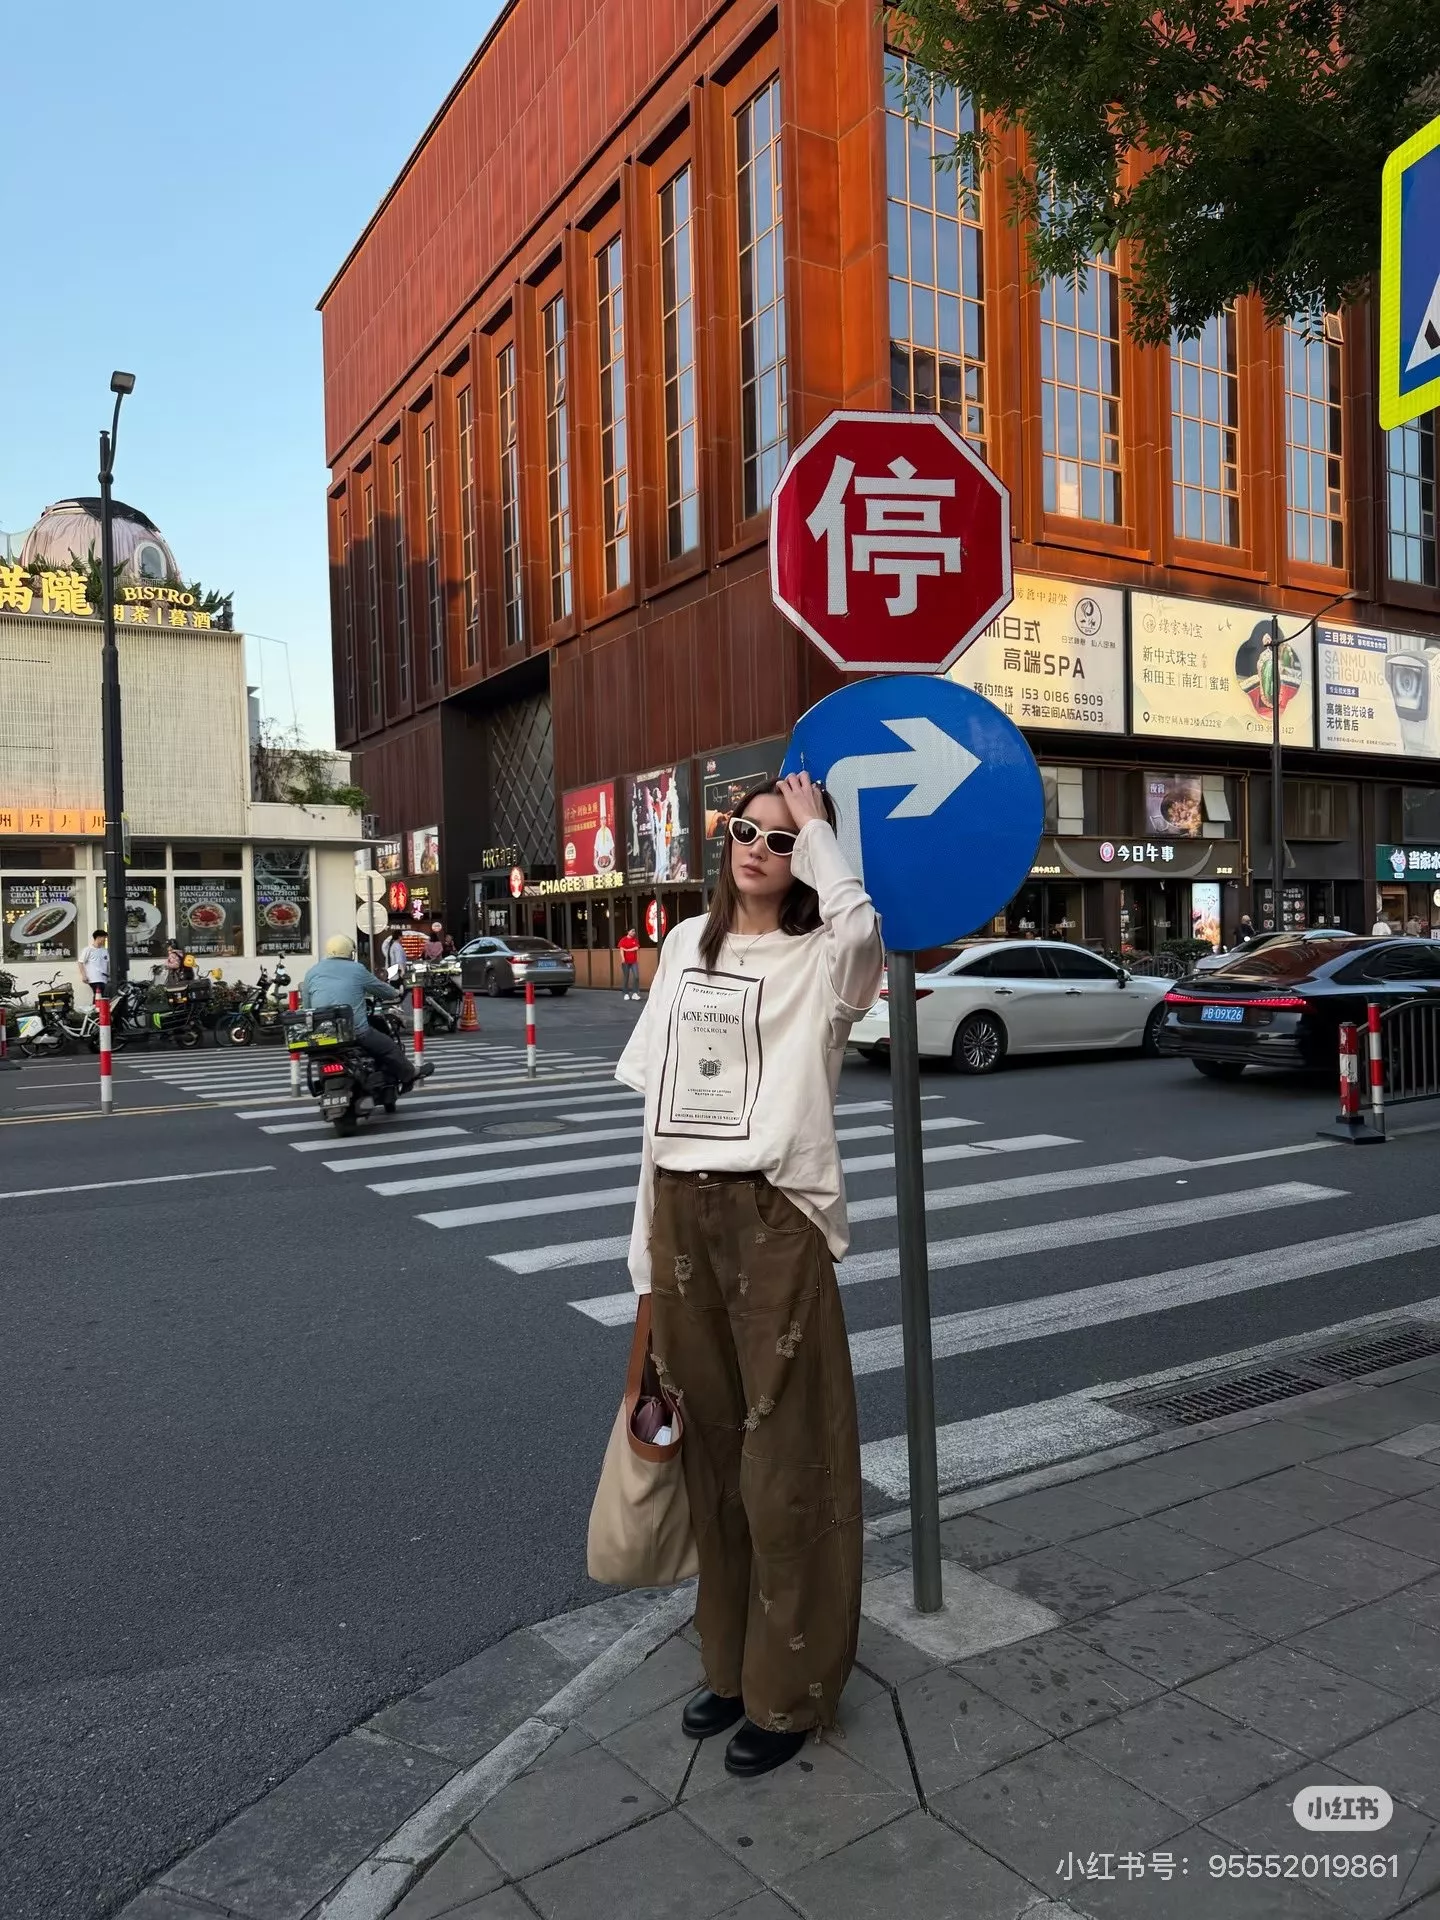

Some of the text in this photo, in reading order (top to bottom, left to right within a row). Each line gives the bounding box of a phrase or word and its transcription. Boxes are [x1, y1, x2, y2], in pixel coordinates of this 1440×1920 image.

[805, 455, 961, 616] 停
[122, 586, 195, 606] BISTRO
[1324, 631, 1355, 646] 三目视光
[1003, 648, 1085, 680] 高端SPA
[1143, 646, 1197, 667] 新中式珠宝
[1325, 650, 1366, 669] SANMU
[1325, 665, 1385, 686] SHIGUANG
[1022, 688, 1039, 700] 153
[1044, 690, 1069, 703] 0186
[1074, 693, 1104, 707] 6909
[1326, 703, 1375, 719] 高端验光设备
[1326, 717, 1359, 731] 无忧售后
[1117, 843, 1174, 862] 今日牛事
[540, 878, 581, 896] CHAGEE
[681, 1011, 740, 1025] ACNE STUDIOS
[693, 1026, 727, 1034] STOCKHOLM
